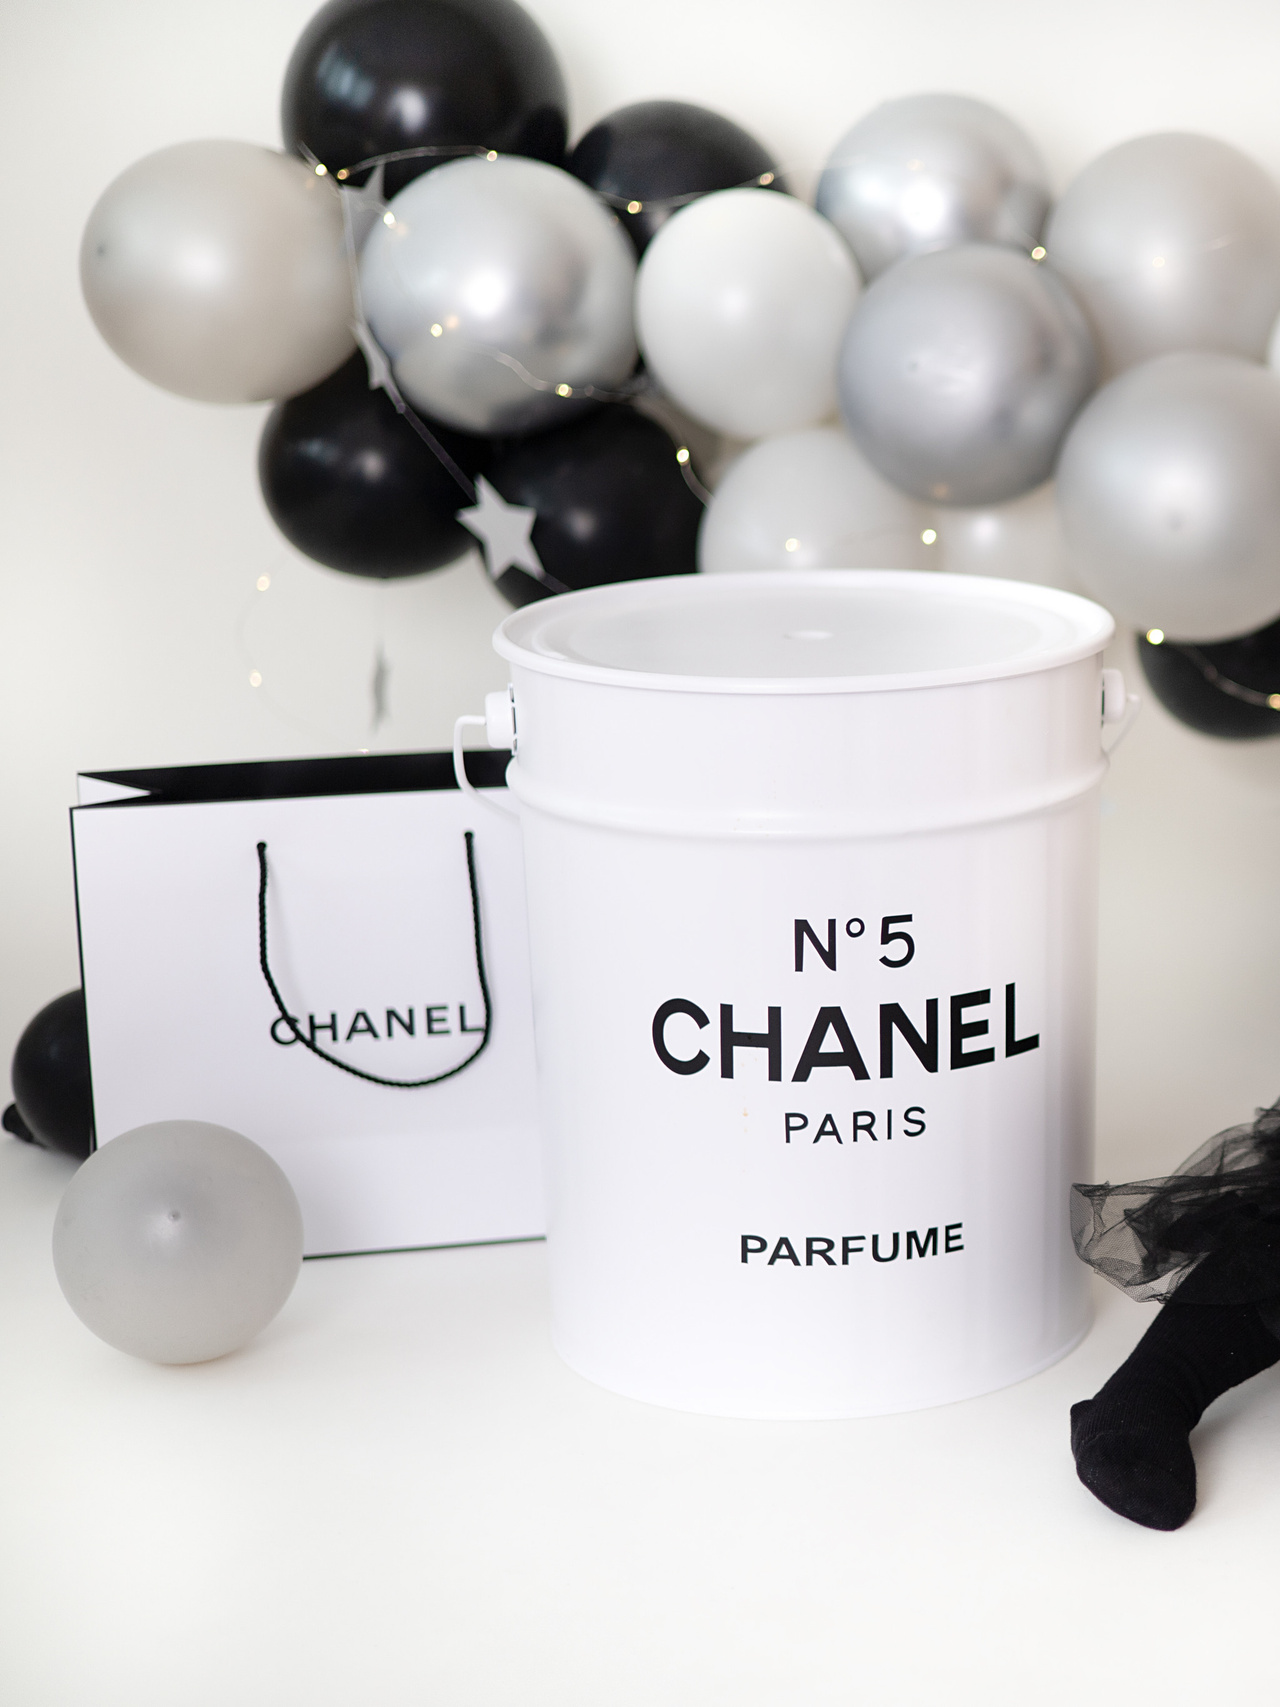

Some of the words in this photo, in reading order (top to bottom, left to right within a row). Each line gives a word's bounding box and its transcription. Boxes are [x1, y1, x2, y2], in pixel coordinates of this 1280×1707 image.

[269, 1004, 486, 1046] CHANEL
[651, 981, 1041, 1083] CHANEL
[784, 1106, 927, 1145] PARIS
[740, 1222, 965, 1267] PARFUME
